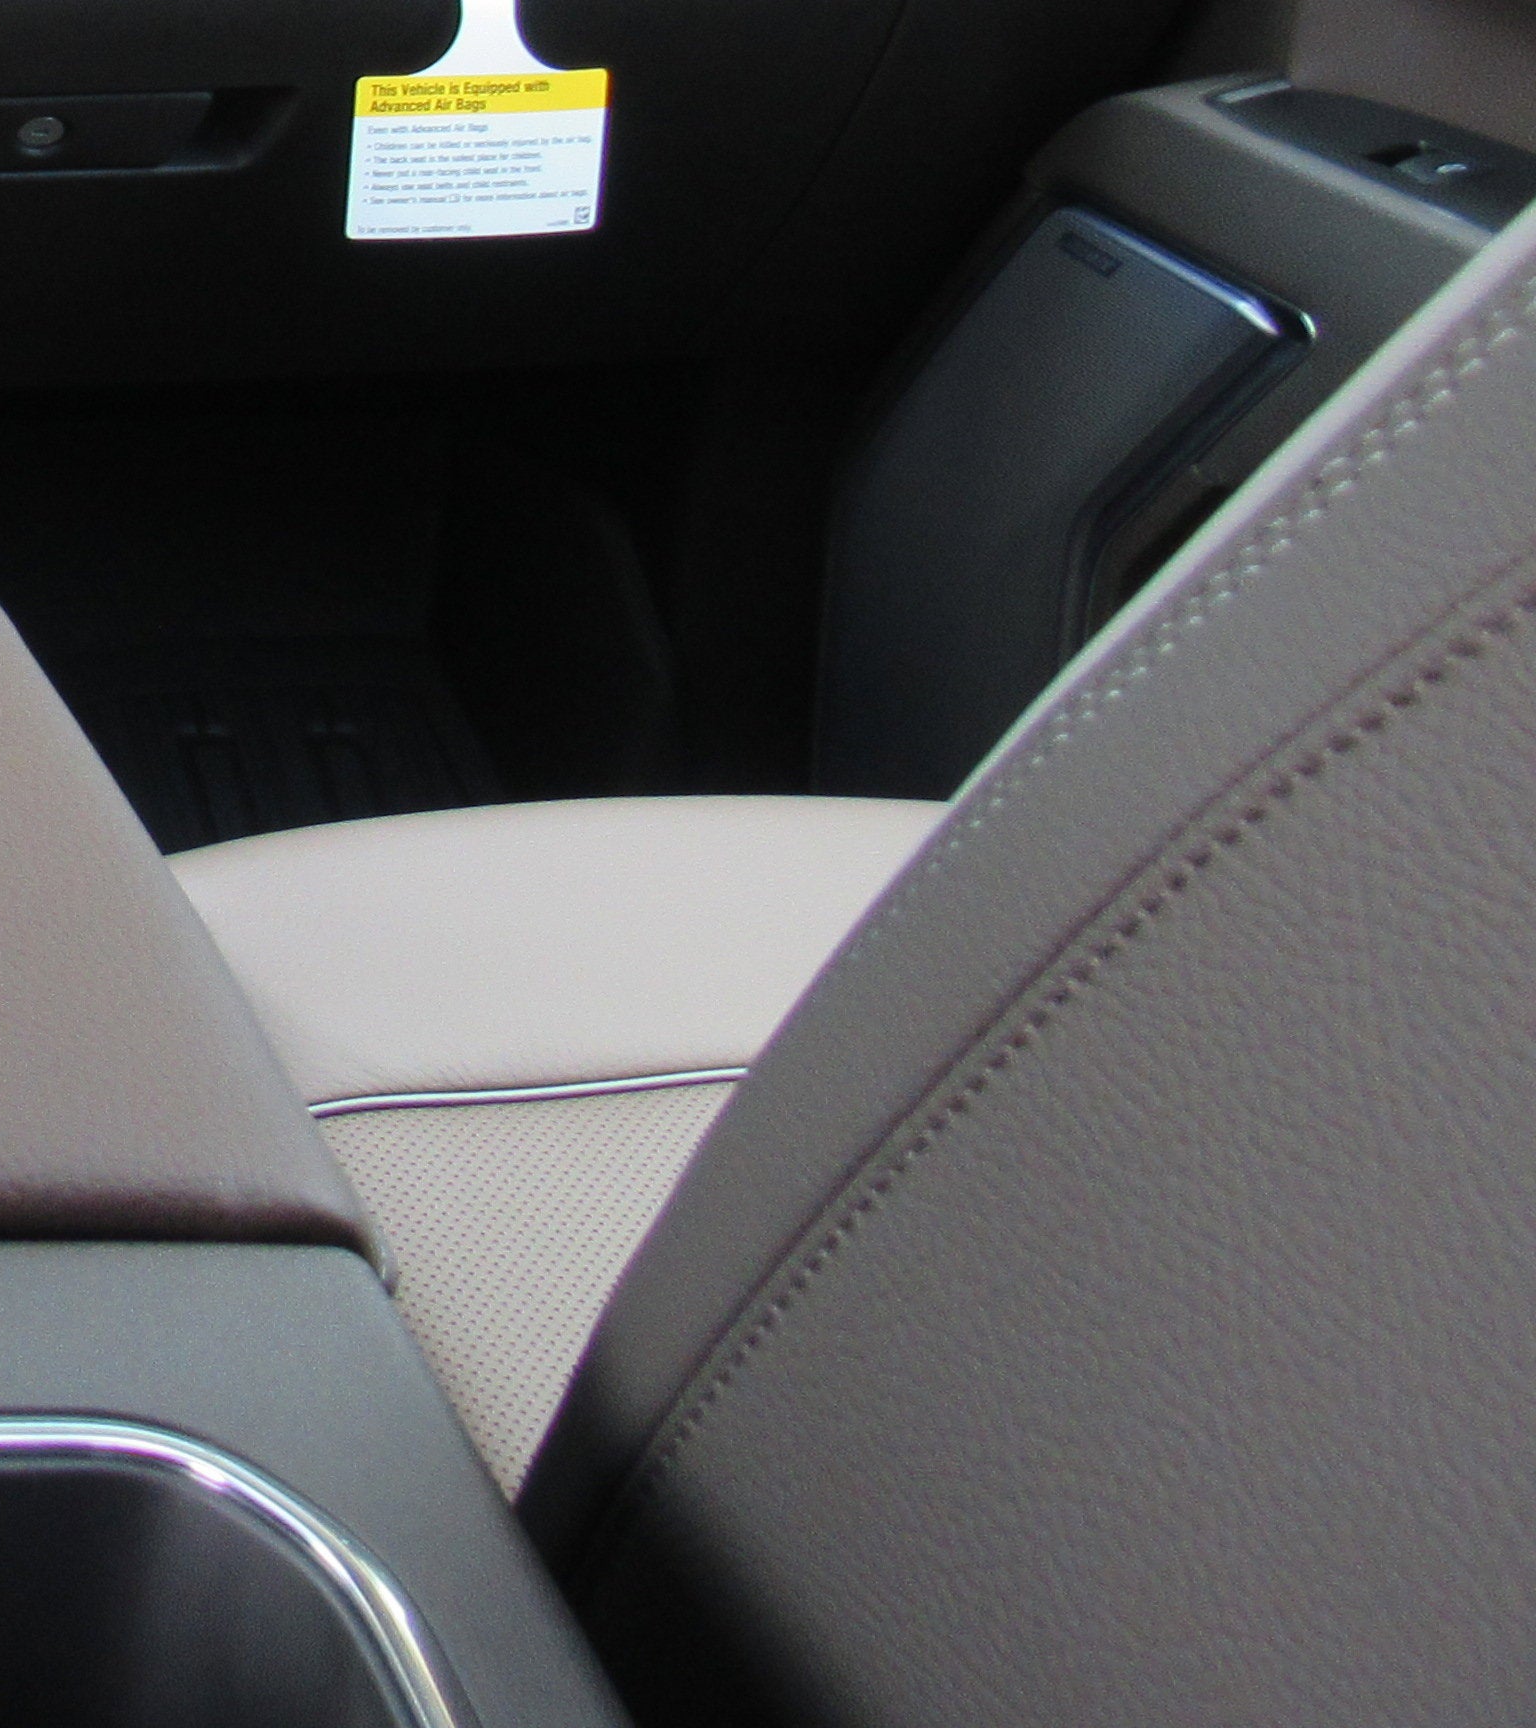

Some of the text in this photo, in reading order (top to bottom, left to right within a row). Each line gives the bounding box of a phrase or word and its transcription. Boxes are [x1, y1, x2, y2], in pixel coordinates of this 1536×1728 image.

[371, 79, 550, 97] This Vehicle is Equipped with
[370, 98, 487, 113] Advanced Air Bags
